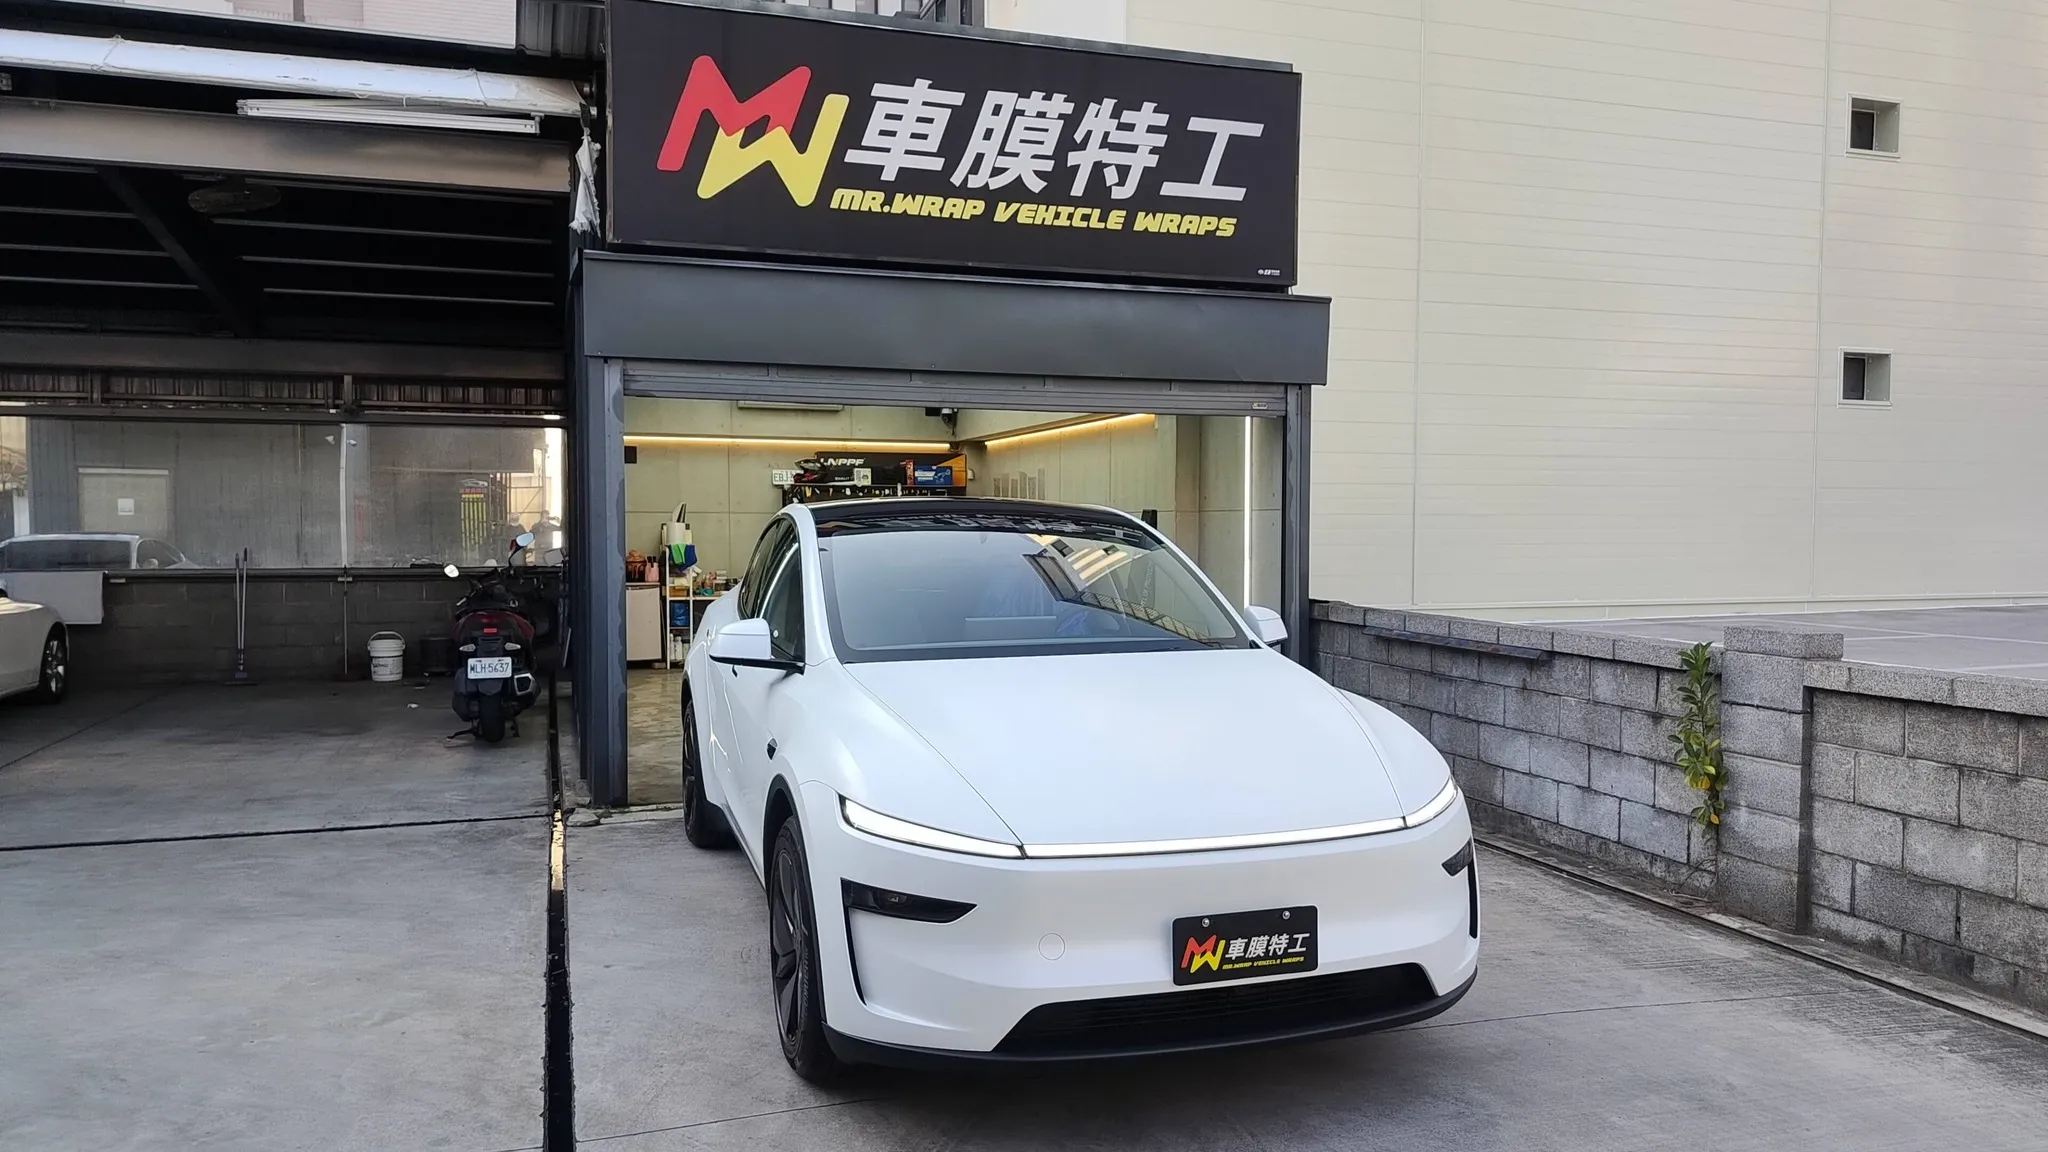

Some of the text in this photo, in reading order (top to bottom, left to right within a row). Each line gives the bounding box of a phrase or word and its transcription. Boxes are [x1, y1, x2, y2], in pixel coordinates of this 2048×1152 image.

[844, 78, 1265, 202] 車膜特工
[830, 188, 1238, 237] MR.WRAP VEHICLE WRAPS
[1225, 933, 1310, 960] 車膜特工
